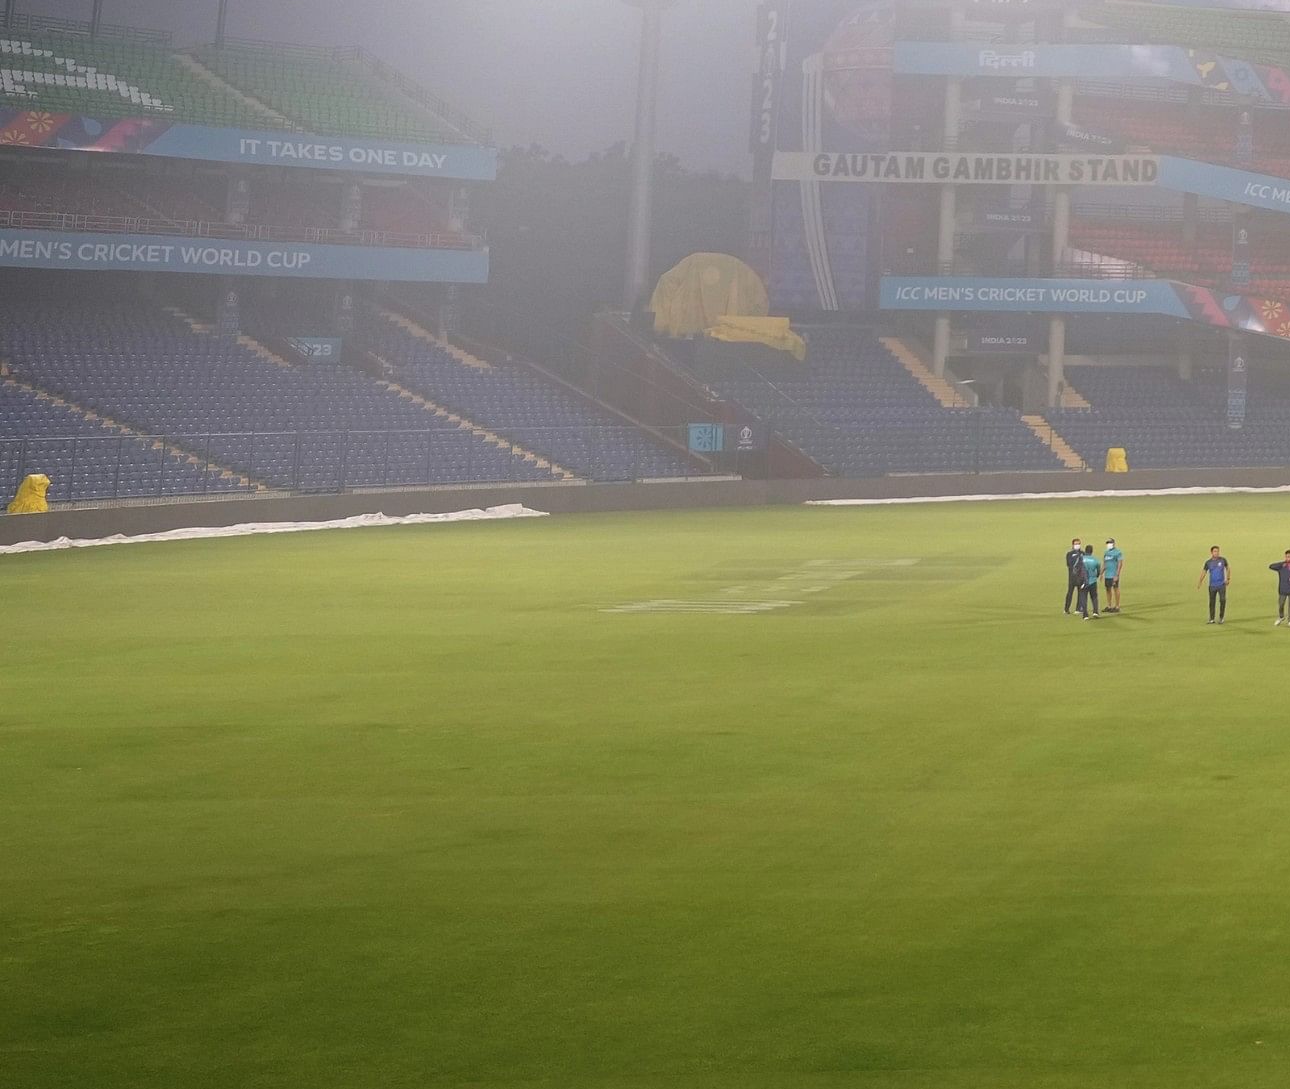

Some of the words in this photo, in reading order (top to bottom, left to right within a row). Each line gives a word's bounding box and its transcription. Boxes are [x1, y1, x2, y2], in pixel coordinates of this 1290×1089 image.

[239, 138, 261, 155] IT
[267, 140, 343, 161] TAKES
[349, 147, 397, 166] ONE
[402, 151, 447, 169] DAY
[813, 153, 925, 179] GAUTAM
[932, 154, 1060, 182] GAMBHIR
[1068, 159, 1157, 183] STAND
[1243, 181, 1272, 200] ICC
[0, 239, 72, 260] MEN'S
[77, 242, 174, 263] CRICKET
[181, 246, 262, 268] WORLD
[266, 250, 311, 269] CUP
[895, 286, 921, 301] ICC
[924, 286, 974, 301] MEN'S
[977, 287, 1047, 302] CRICKET
[1050, 288, 1110, 303] WORLD
[1113, 289, 1147, 304] CUP
